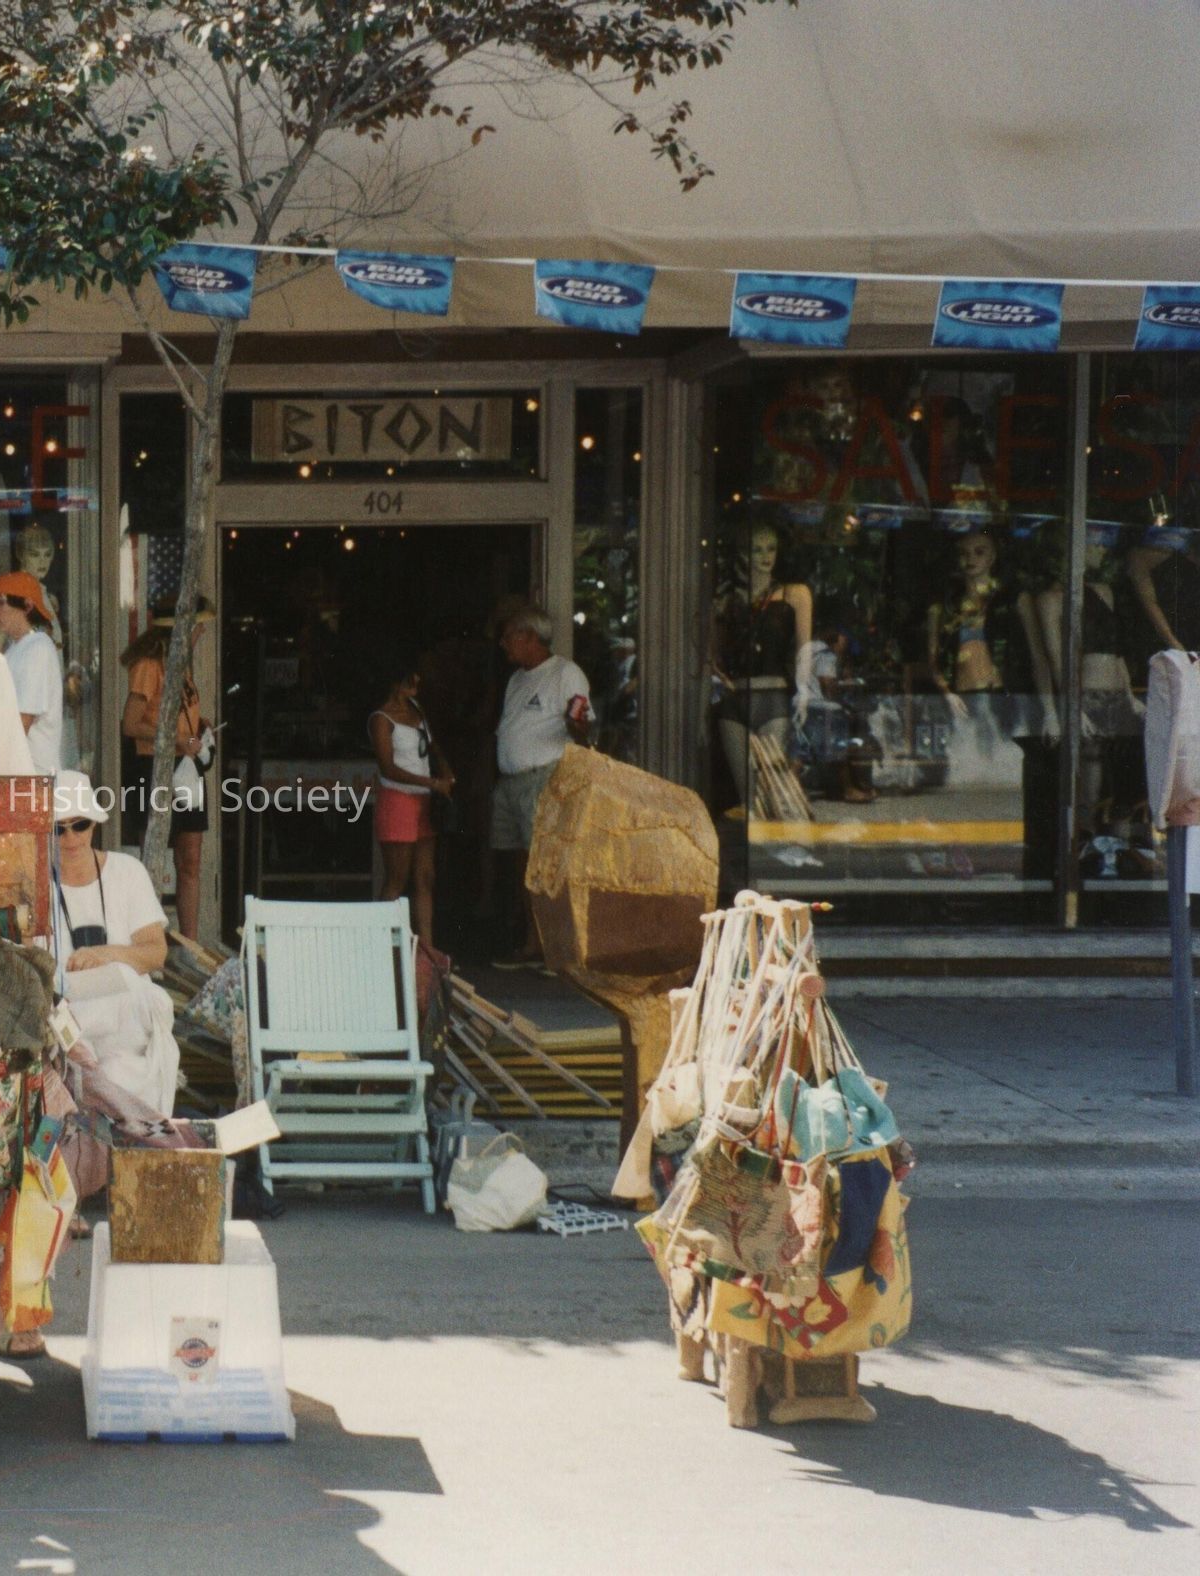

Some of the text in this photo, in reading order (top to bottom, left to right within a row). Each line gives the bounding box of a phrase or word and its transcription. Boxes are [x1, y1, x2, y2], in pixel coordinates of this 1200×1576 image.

[168, 265, 225, 279] BUD
[367, 263, 425, 277] BUD
[354, 270, 432, 285] LIGHT
[564, 280, 621, 294] BUD
[551, 286, 628, 303] LIGHT
[765, 296, 824, 308] BUD
[971, 303, 1033, 314] BUD
[752, 303, 832, 317] LIGHT
[960, 310, 1040, 323] LIGHT
[282, 402, 483, 455] BITON
[758, 394, 1063, 503] SALE
[363, 491, 404, 515] 404
